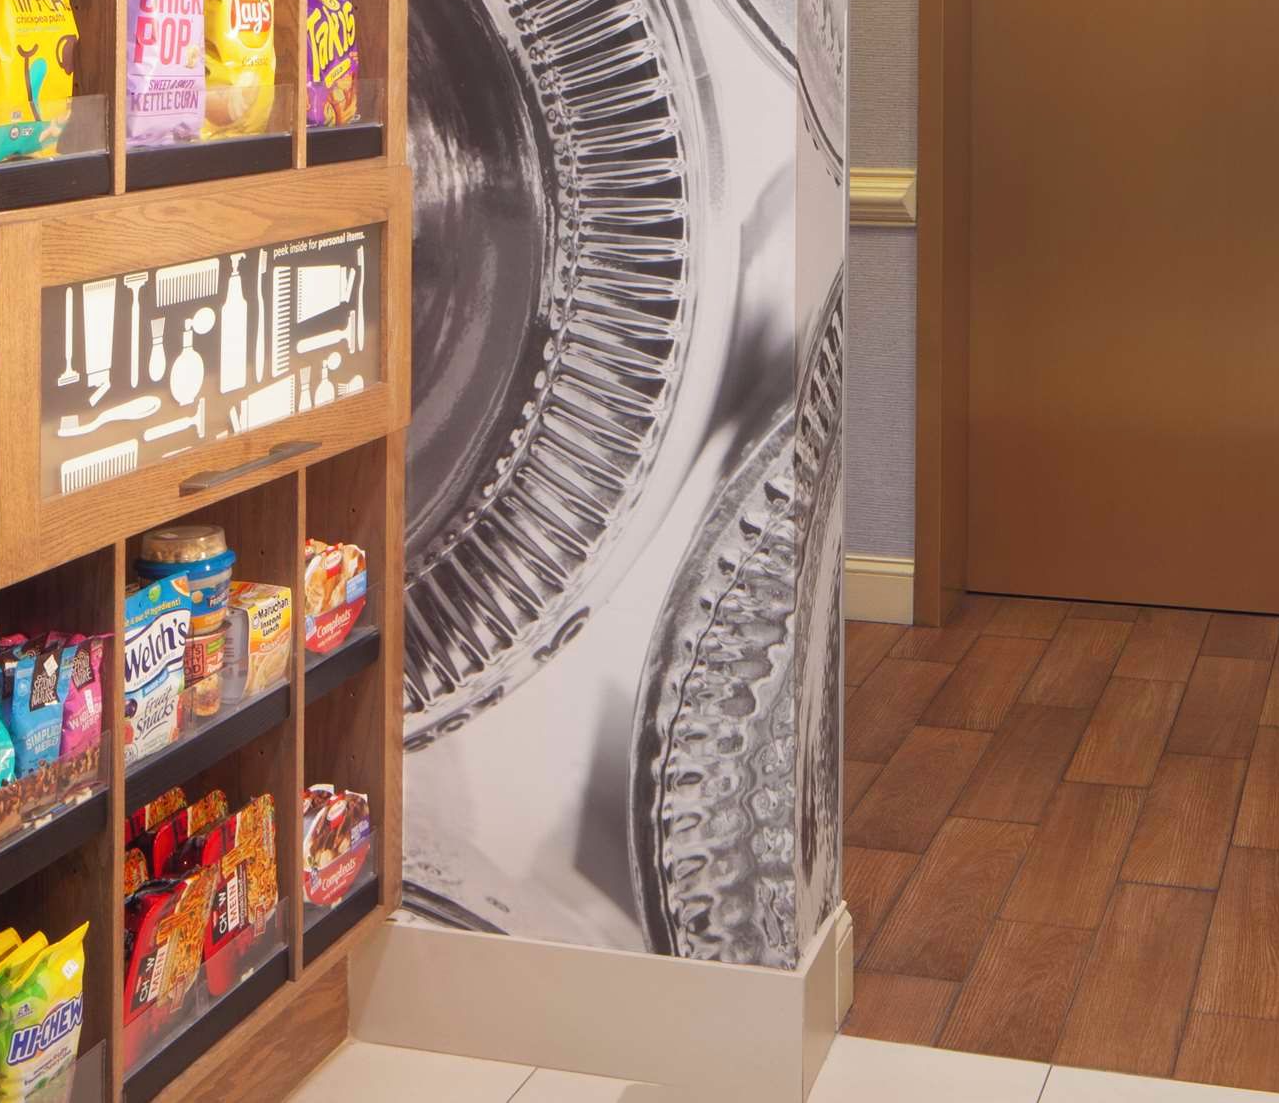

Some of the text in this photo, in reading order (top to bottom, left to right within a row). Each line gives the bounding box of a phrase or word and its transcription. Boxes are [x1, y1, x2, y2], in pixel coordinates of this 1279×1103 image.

[16, 13, 50, 26] chickpea
[133, 15, 192, 67] POP
[130, 91, 172, 113] KETTLE
[125, 618, 187, 683] Welch's
[134, 700, 176, 741] Snacks
[143, 688, 173, 719] Fruit
[229, 882, 239, 925] MEIN
[149, 950, 167, 995] MEIN
[8, 993, 84, 1065] HI-CHEW
